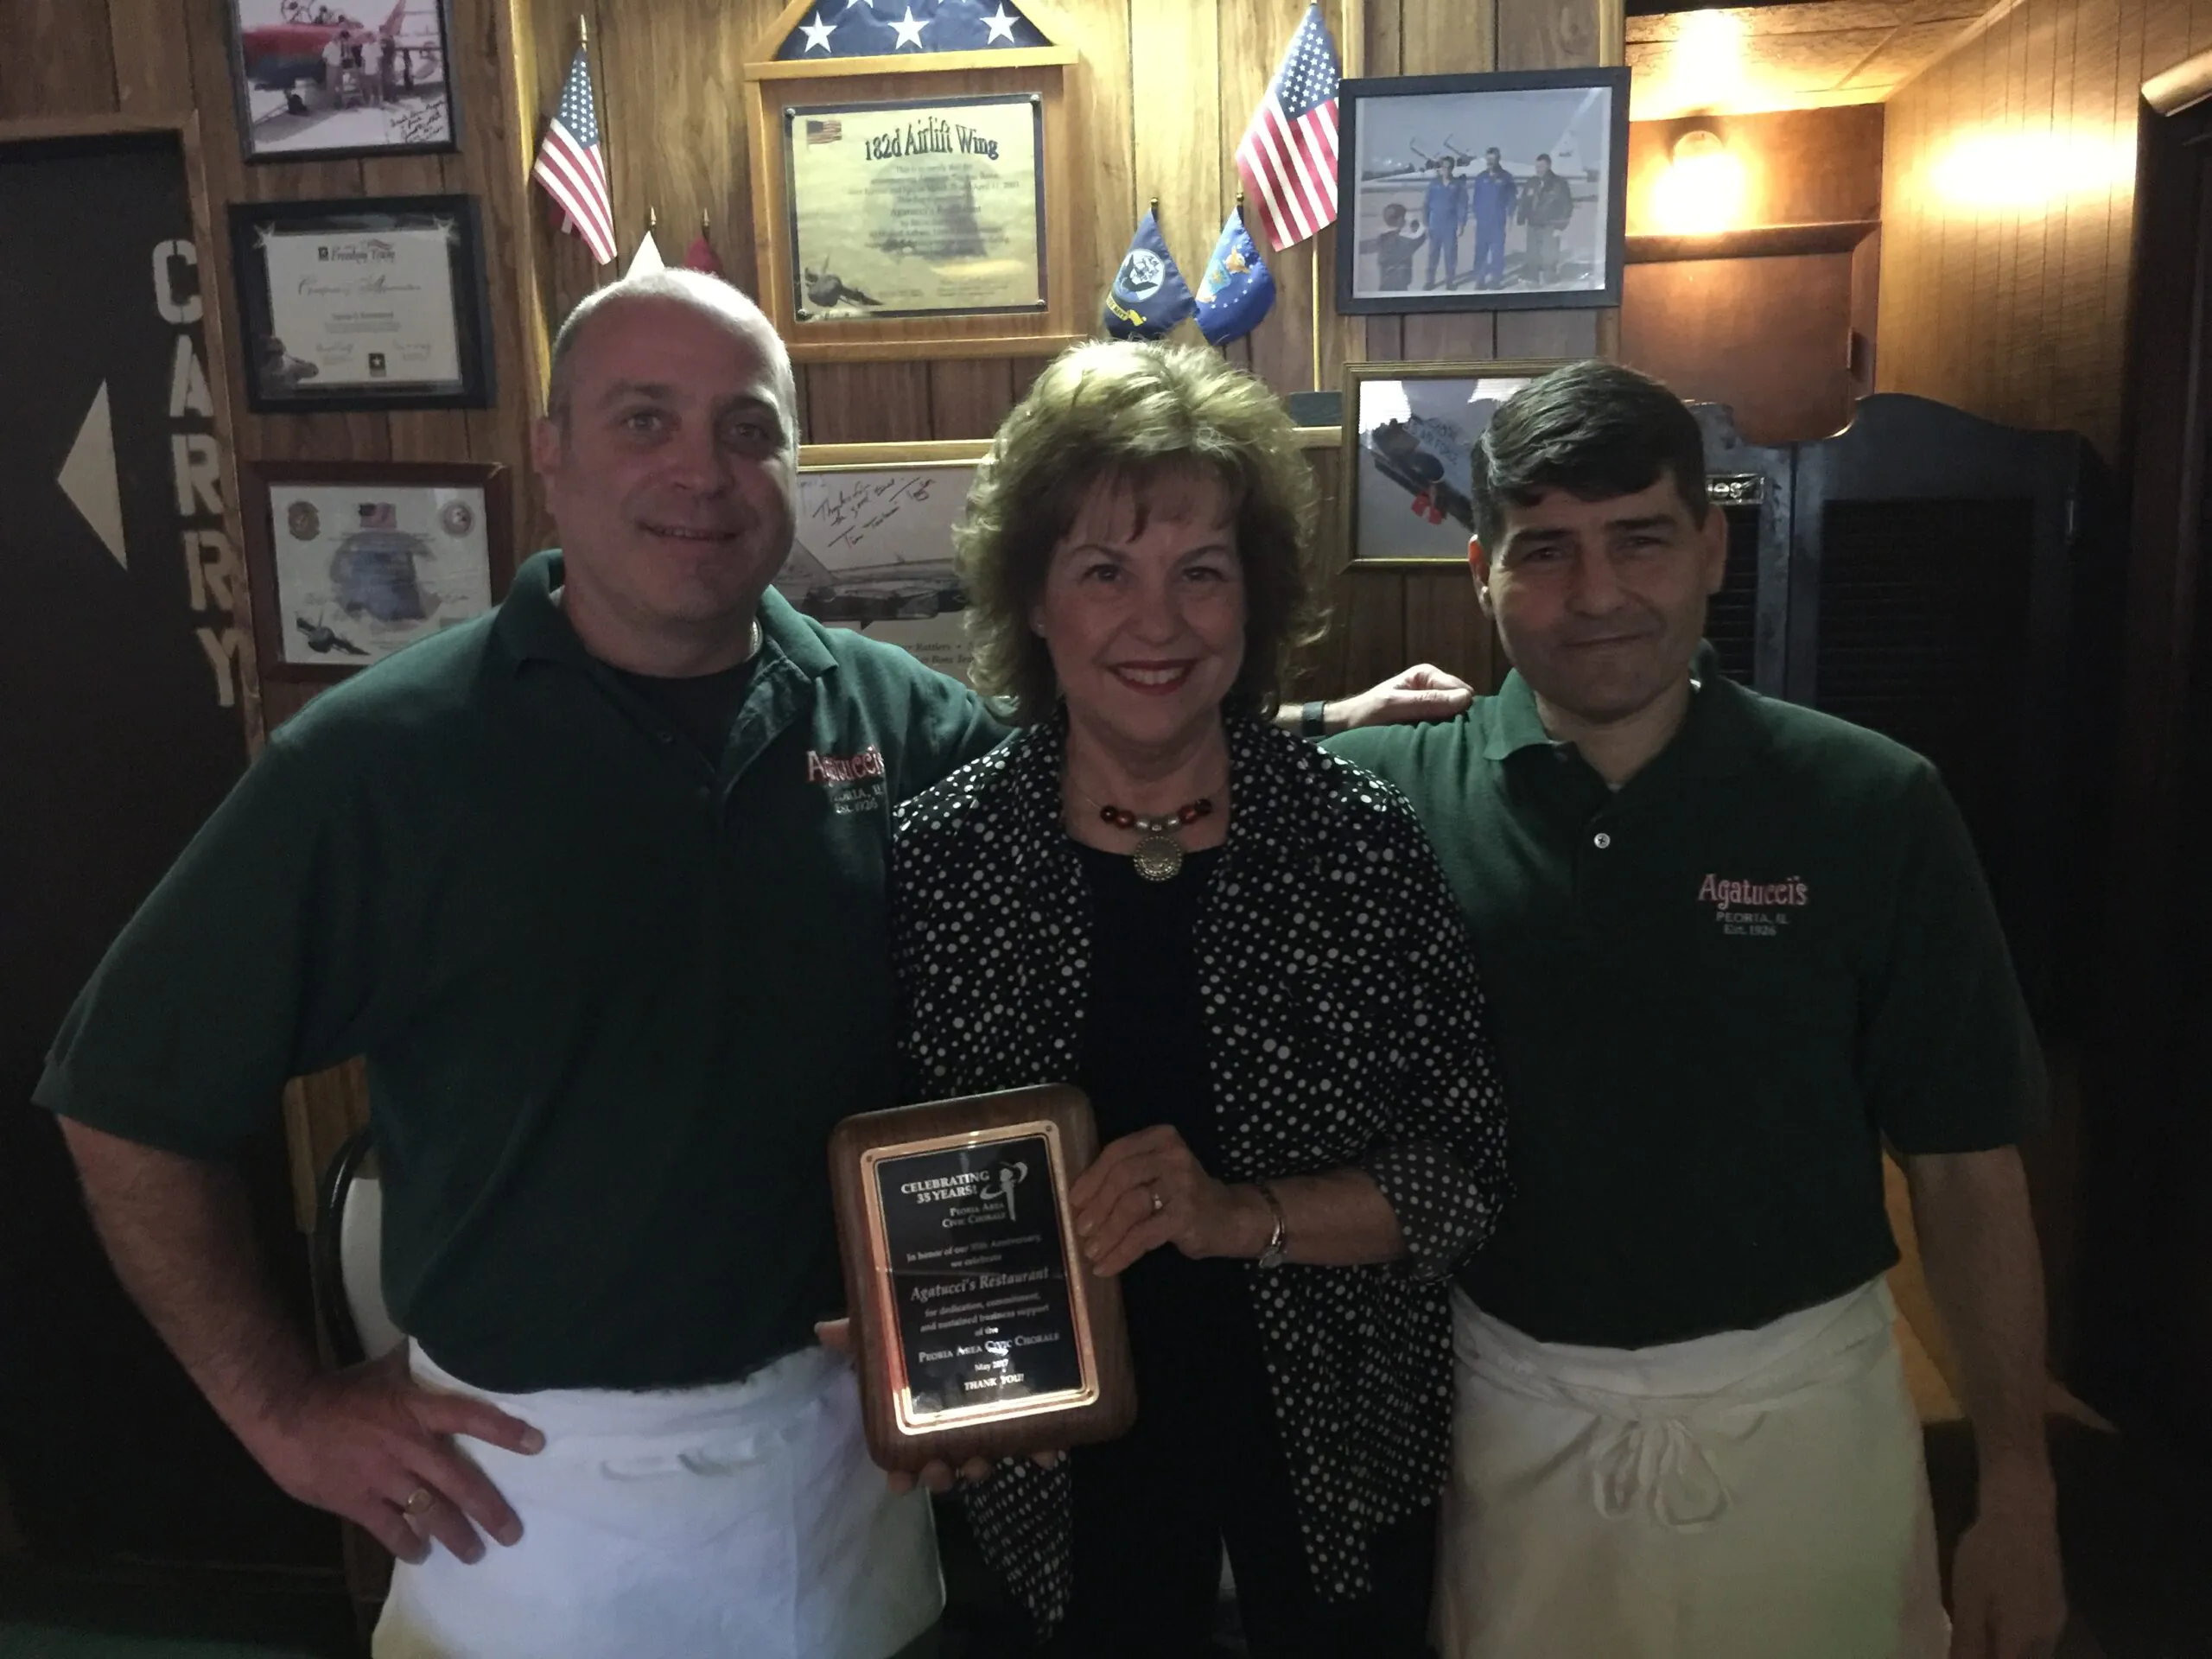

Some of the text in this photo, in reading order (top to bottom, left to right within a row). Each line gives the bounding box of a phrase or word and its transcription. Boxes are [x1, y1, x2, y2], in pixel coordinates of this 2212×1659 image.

[865, 116, 999, 161] 182d Airlift Wing
[152, 238, 240, 708] CARRY
[1696, 873, 1808, 911] Agatucci's
[900, 1170, 990, 1194] CELEBRATING
[916, 1184, 978, 1205] 35 YEARS!
[917, 1249, 943, 1261] honor
[944, 1246, 953, 1255] of
[953, 1246, 969, 1255] our
[950, 1255, 1002, 1268] we celebrate
[910, 1266, 1049, 1304] Agatucci's Restaurant
[919, 1303, 1050, 1333] and sustained business support
[925, 1307, 938, 1318] for
[974, 1325, 1000, 1337] of the
[974, 1362, 992, 1373] May
[963, 1376, 997, 1391] THANK
